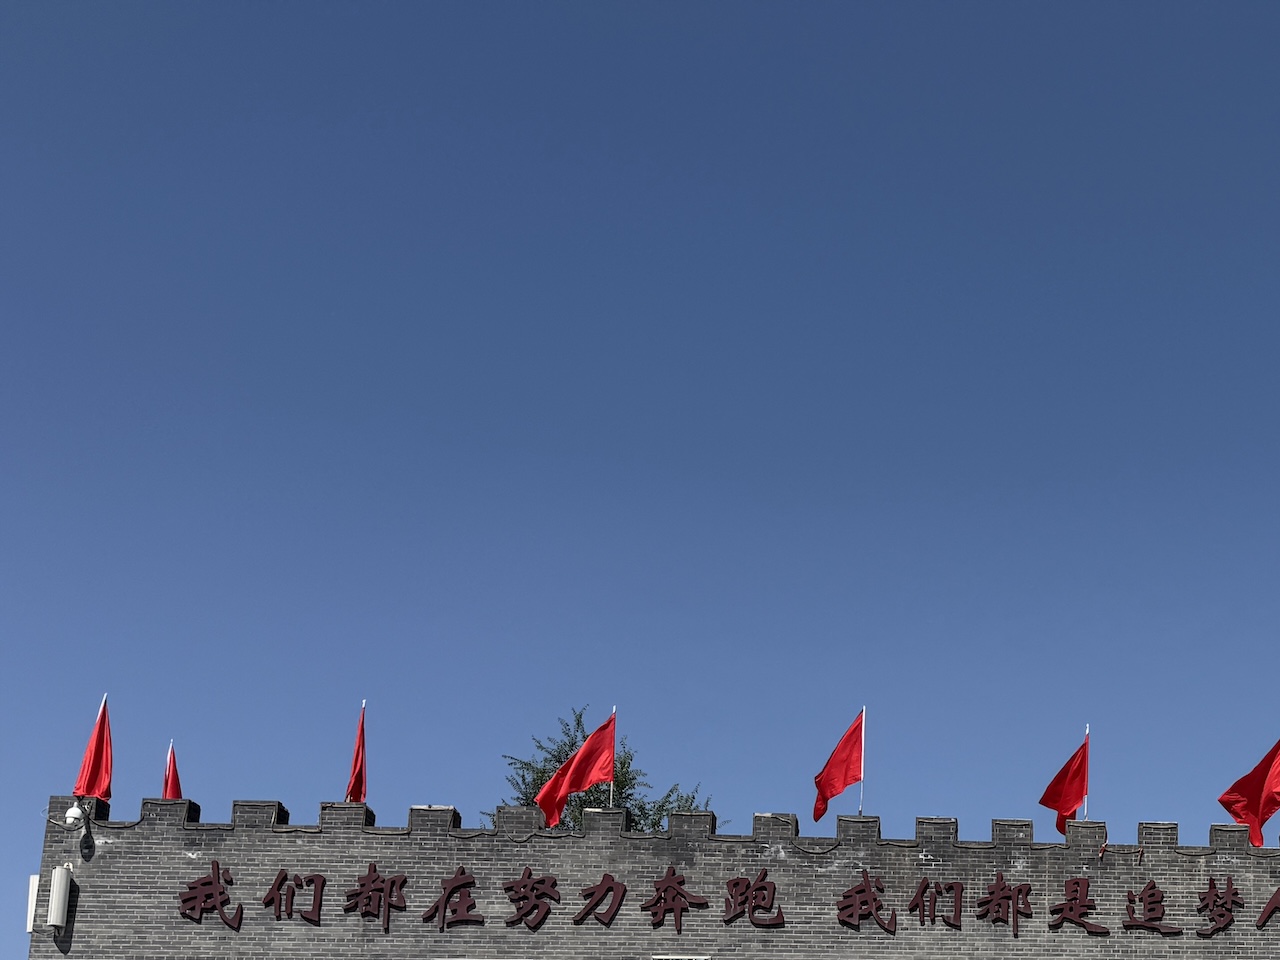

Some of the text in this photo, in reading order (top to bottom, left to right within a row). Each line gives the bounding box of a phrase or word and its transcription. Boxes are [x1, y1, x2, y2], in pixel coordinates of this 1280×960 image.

[177, 861, 785, 934] 我们都在努力奔跑
